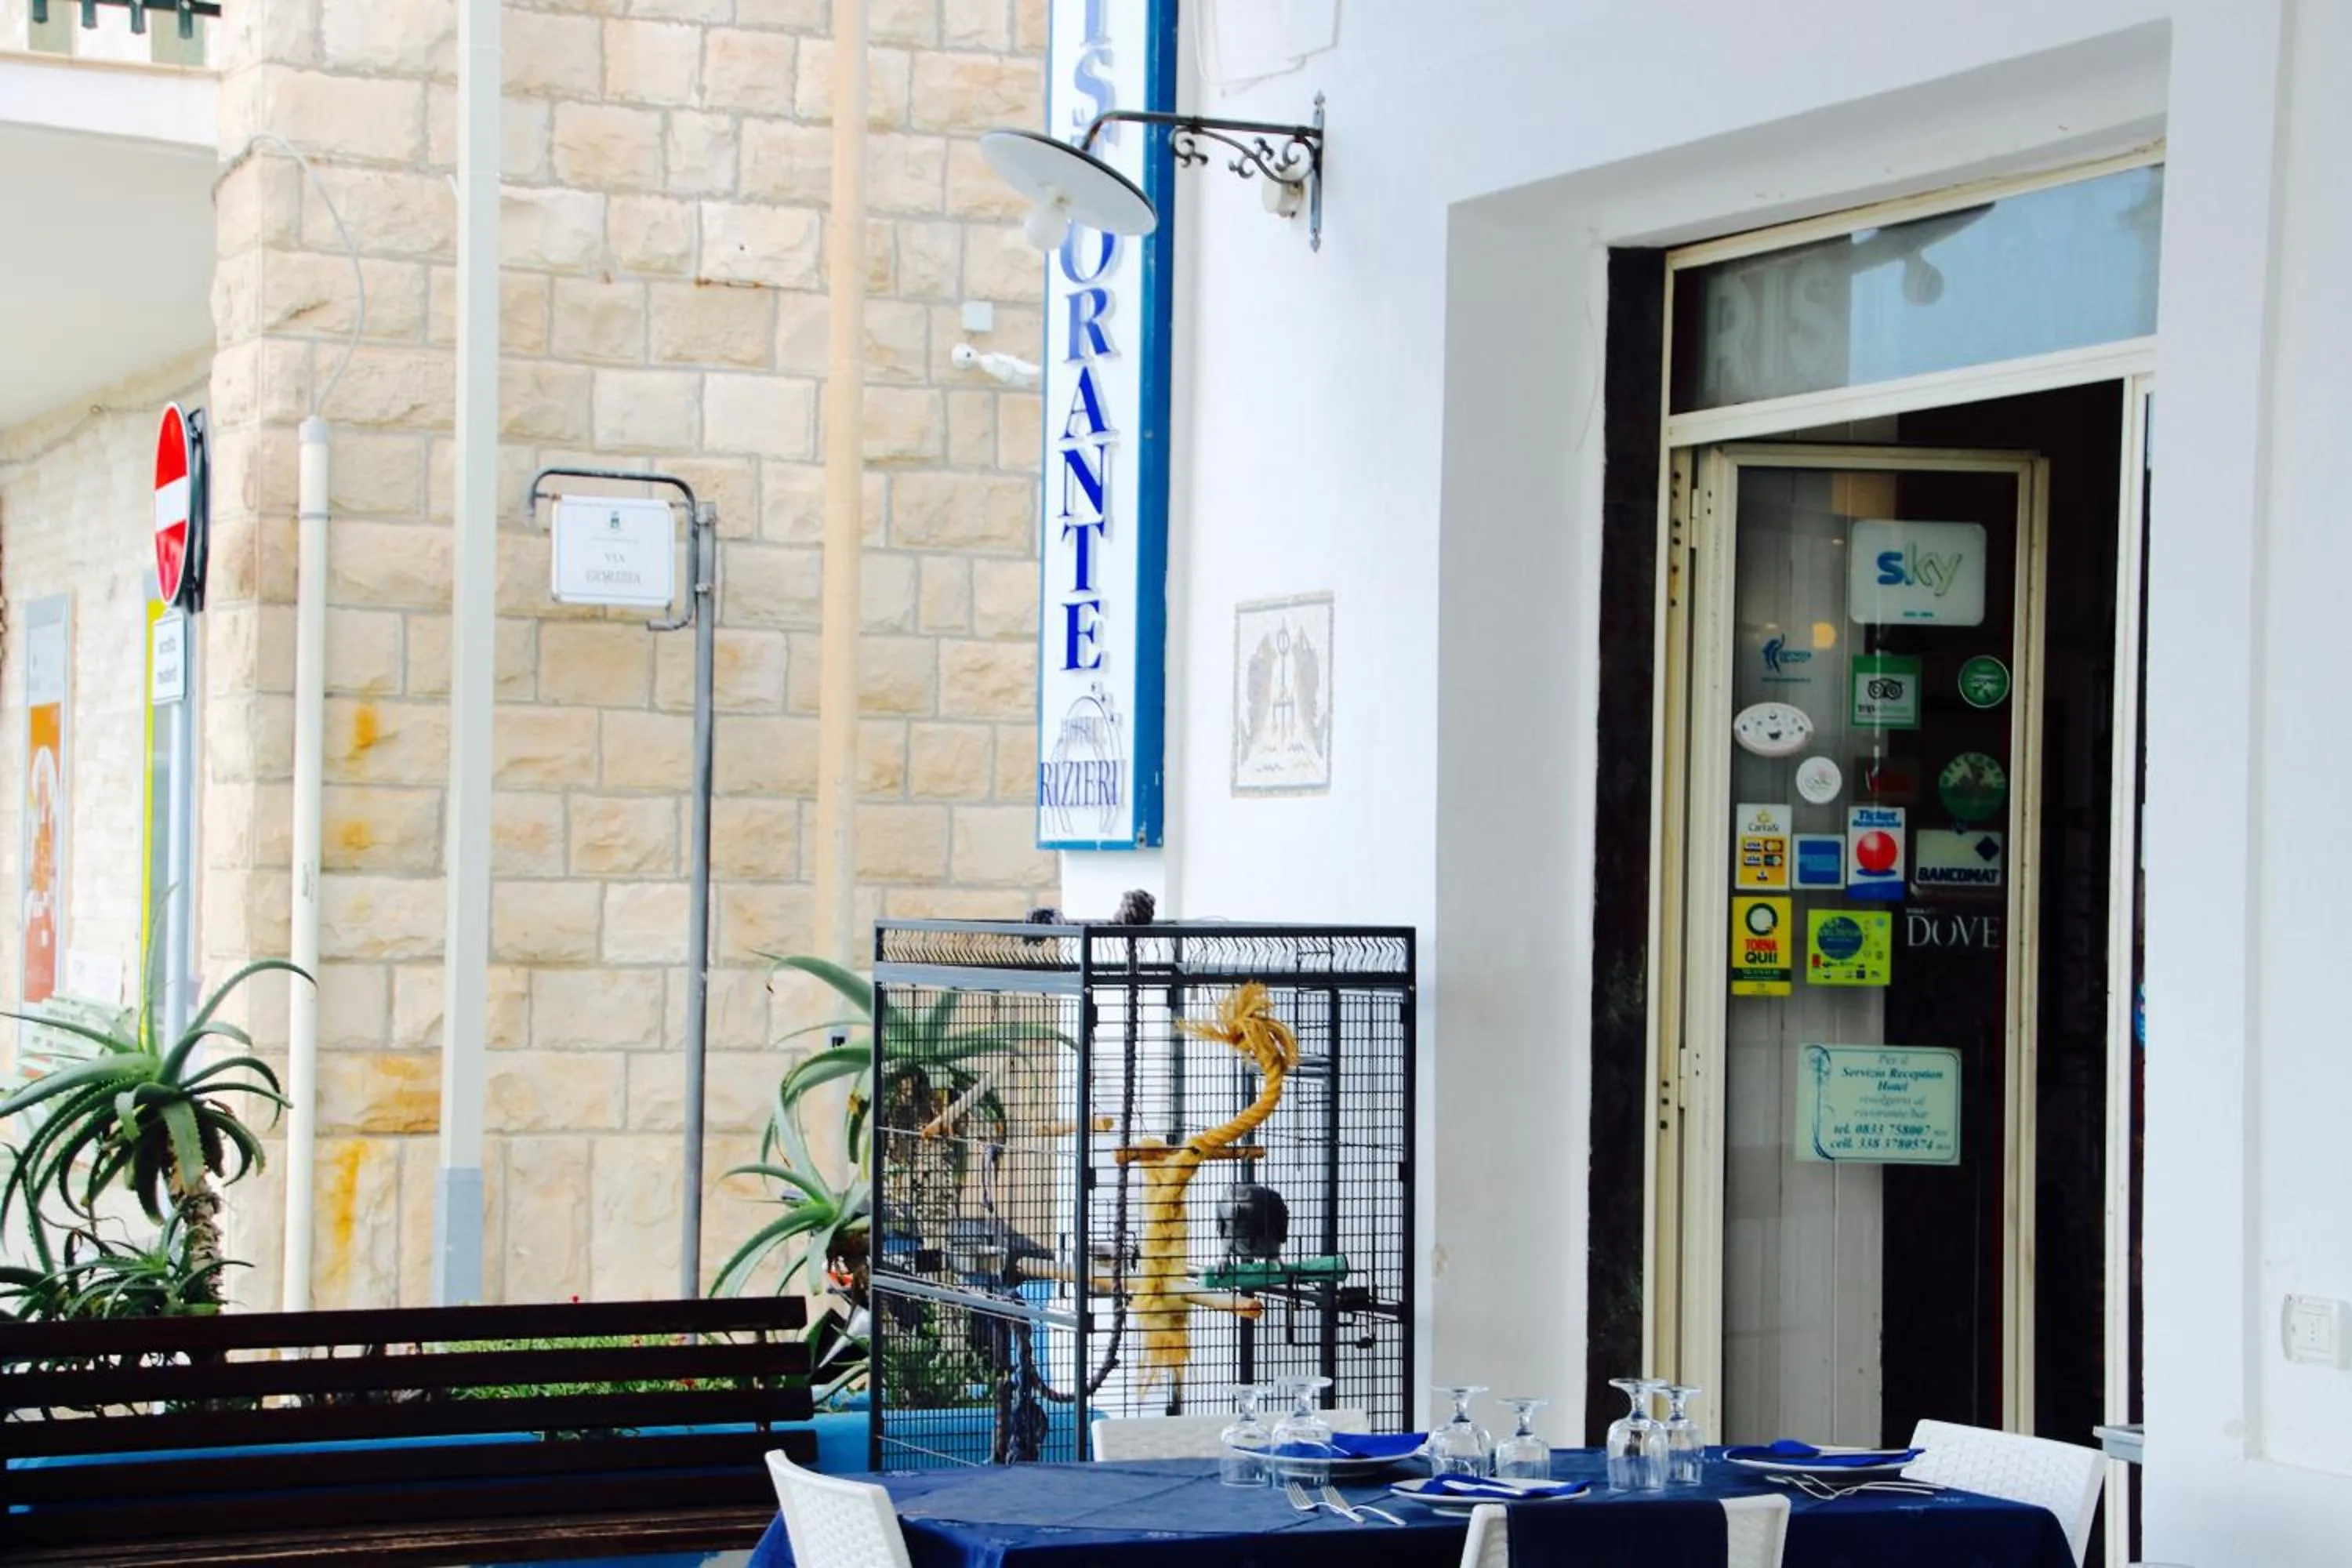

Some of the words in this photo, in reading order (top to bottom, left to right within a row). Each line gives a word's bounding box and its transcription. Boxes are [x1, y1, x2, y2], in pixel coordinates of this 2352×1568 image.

[1877, 541, 1962, 597] sky
[1040, 760, 1117, 806] RIZIERI
[1918, 867, 1999, 882] BANCOMAT
[1907, 915, 2001, 949] DOVE
[1889, 1068, 1943, 1082] Reception
